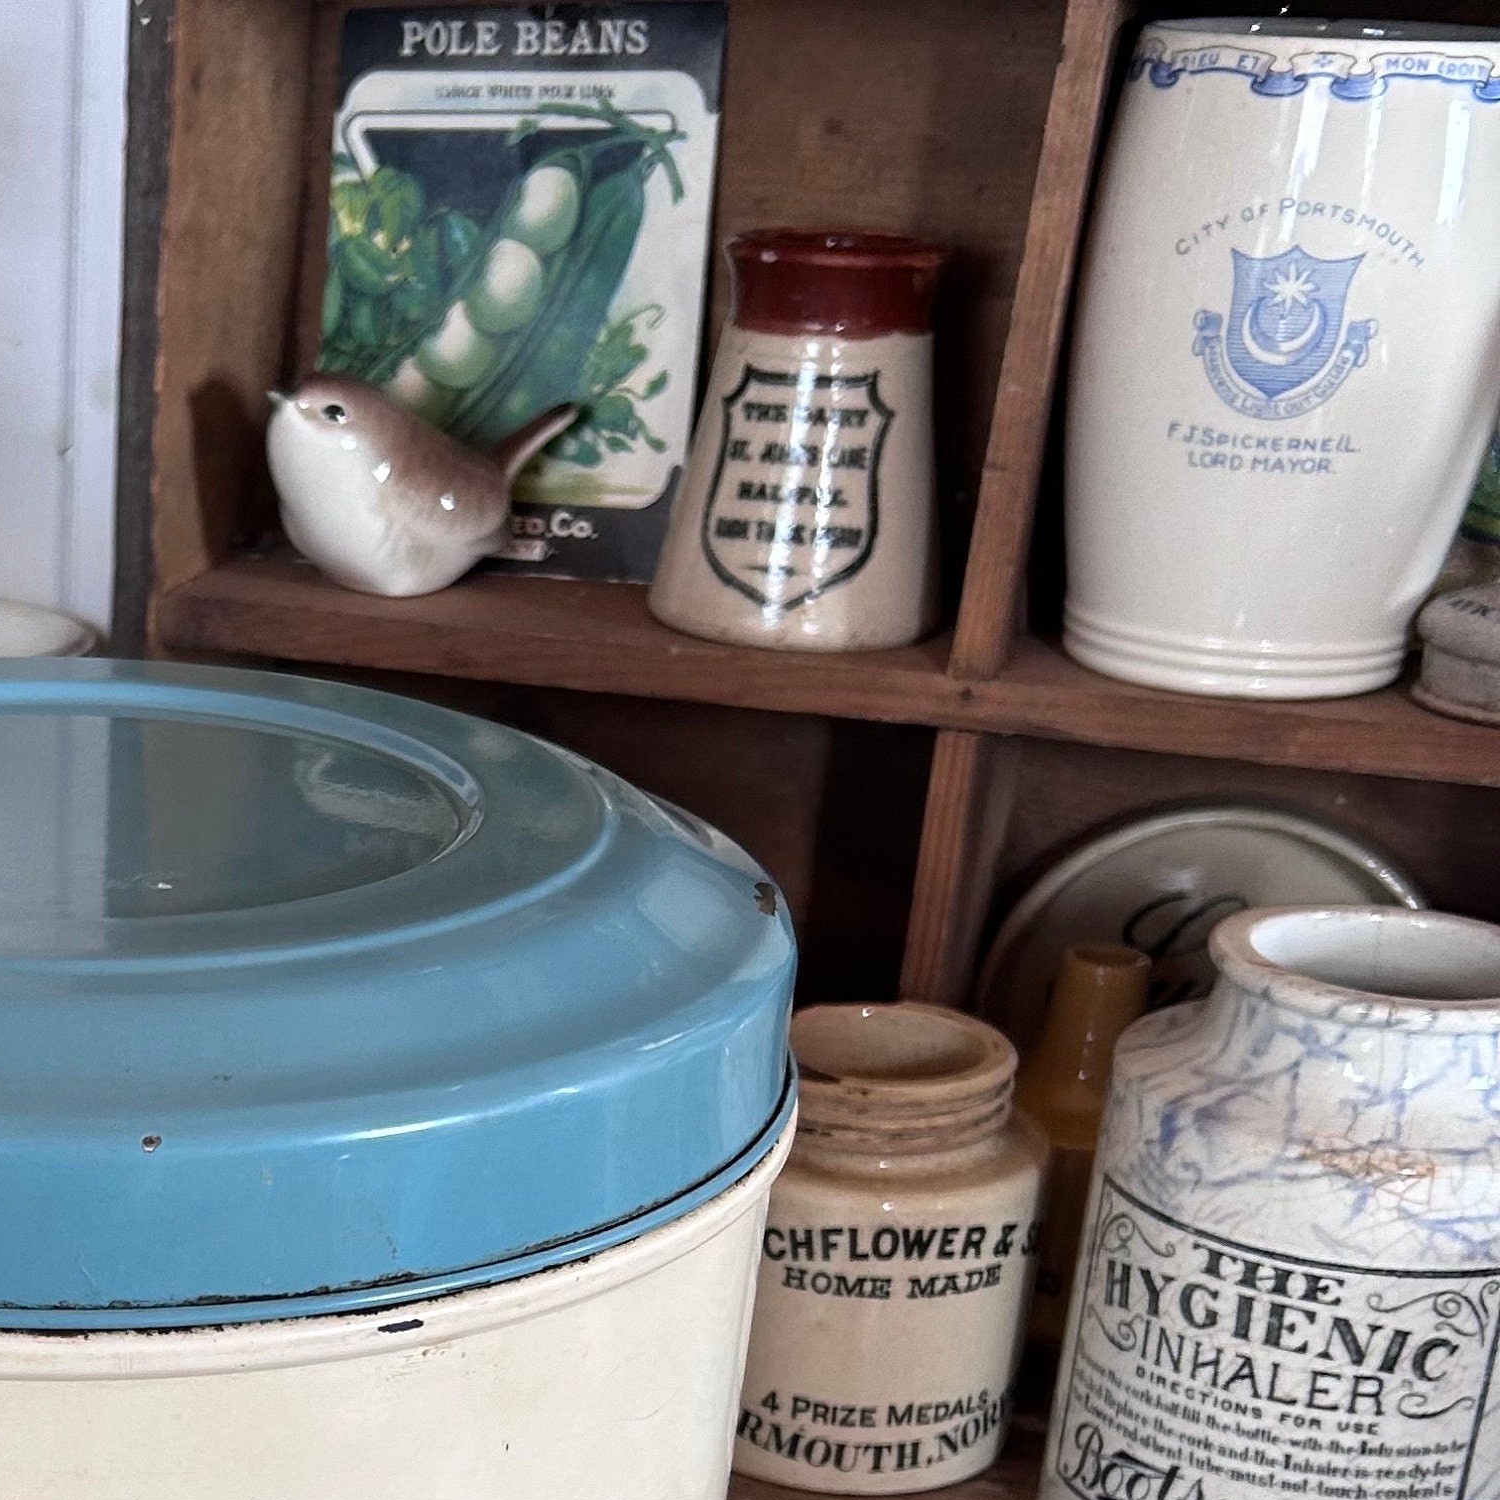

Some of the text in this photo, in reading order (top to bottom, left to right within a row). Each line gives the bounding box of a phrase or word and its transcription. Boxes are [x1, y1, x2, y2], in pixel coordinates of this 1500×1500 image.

[401, 19, 649, 57] POLE BEANS
[1239, 55, 1262, 72] ET
[1385, 57, 1431, 73] MON
[1175, 197, 1426, 269] CITY OF PORTSMOUTH
[1186, 451, 1244, 471] LORD
[762, 1224, 987, 1263] CHFLOWER
[993, 1221, 1018, 1259] &
[781, 1265, 892, 1300] HOME
[906, 1263, 1003, 1300] MADE
[1193, 1242, 1345, 1306] THE
[1103, 1258, 1460, 1382] HYGIENIC
[1139, 1319, 1385, 1417] INHALER
[759, 1389, 781, 1416] 4
[790, 1395, 877, 1429] PRIZE
[1135, 1364, 1380, 1435] DIRECTIONS FOR USE
[1235, 1422, 1281, 1446] bottle
